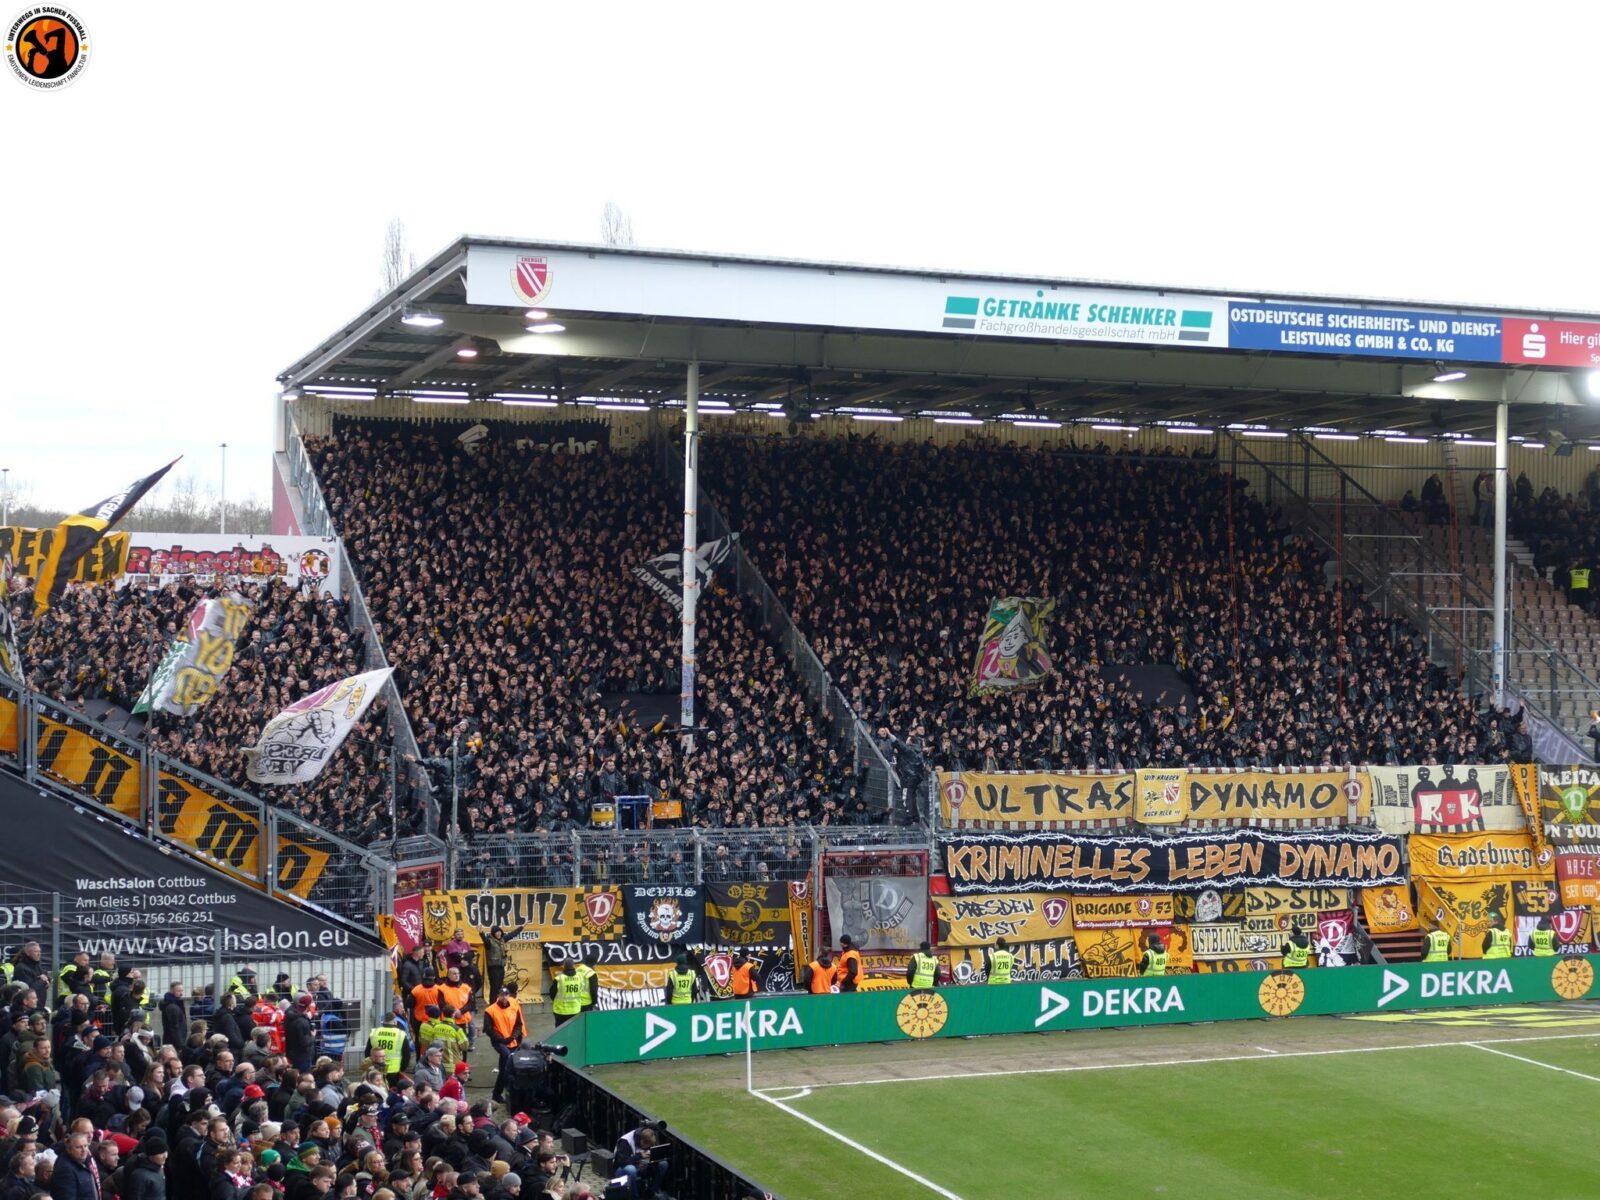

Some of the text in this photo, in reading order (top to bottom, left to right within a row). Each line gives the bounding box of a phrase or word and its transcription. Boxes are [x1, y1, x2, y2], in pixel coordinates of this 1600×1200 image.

[1087, 303, 1177, 326] SCHENKER
[1230, 307, 1501, 337] OSTDEUTSCHE SICHERHEITS- UND DIENST-
[979, 319, 1176, 341] Fachgroßhandelsgesellschaft mbH
[1560, 331, 1585, 345] Hier
[1280, 330, 1455, 353] LEISTUNGS GMBH & CO. KG
[974, 779, 1134, 816] ULTRAS
[1190, 779, 1339, 814] DYNAMO
[1459, 791, 1480, 819] K
[1418, 793, 1443, 823] R
[947, 842, 1400, 883] KRIMINELLES LEBEN DYNAMO
[1437, 841, 1533, 868] Radeburg
[76, 876, 206, 890] WaschSalon Cottbus
[634, 886, 697, 897] DEVILS
[76, 897, 97, 908] Am
[99, 895, 130, 907] Gleis
[132, 895, 140, 907] 5
[149, 895, 186, 907] 03042
[188, 893, 237, 906] Cottbus
[464, 890, 569, 928] GÖRLITZ
[952, 897, 1035, 920] DRESDEN
[1075, 902, 1132, 915] BRIGADE
[1155, 901, 1172, 914] 53
[1527, 892, 1550, 913] 53
[76, 911, 215, 927] Tel. (0355) 756 266 251
[582, 914, 617, 935] DRESDEN
[1240, 913, 1316, 930] Forza SGD
[77, 925, 350, 957] www.waschsalon.eu
[921, 961, 934, 971] 339
[997, 961, 1010, 970] 276
[565, 984, 579, 993] 166
[677, 980, 690, 989] 137
[1420, 968, 1513, 998] DEKRA
[1083, 985, 1186, 1017] DEKRA
[691, 1006, 804, 1043] DEKRA
[378, 1039, 394, 1050] 186
